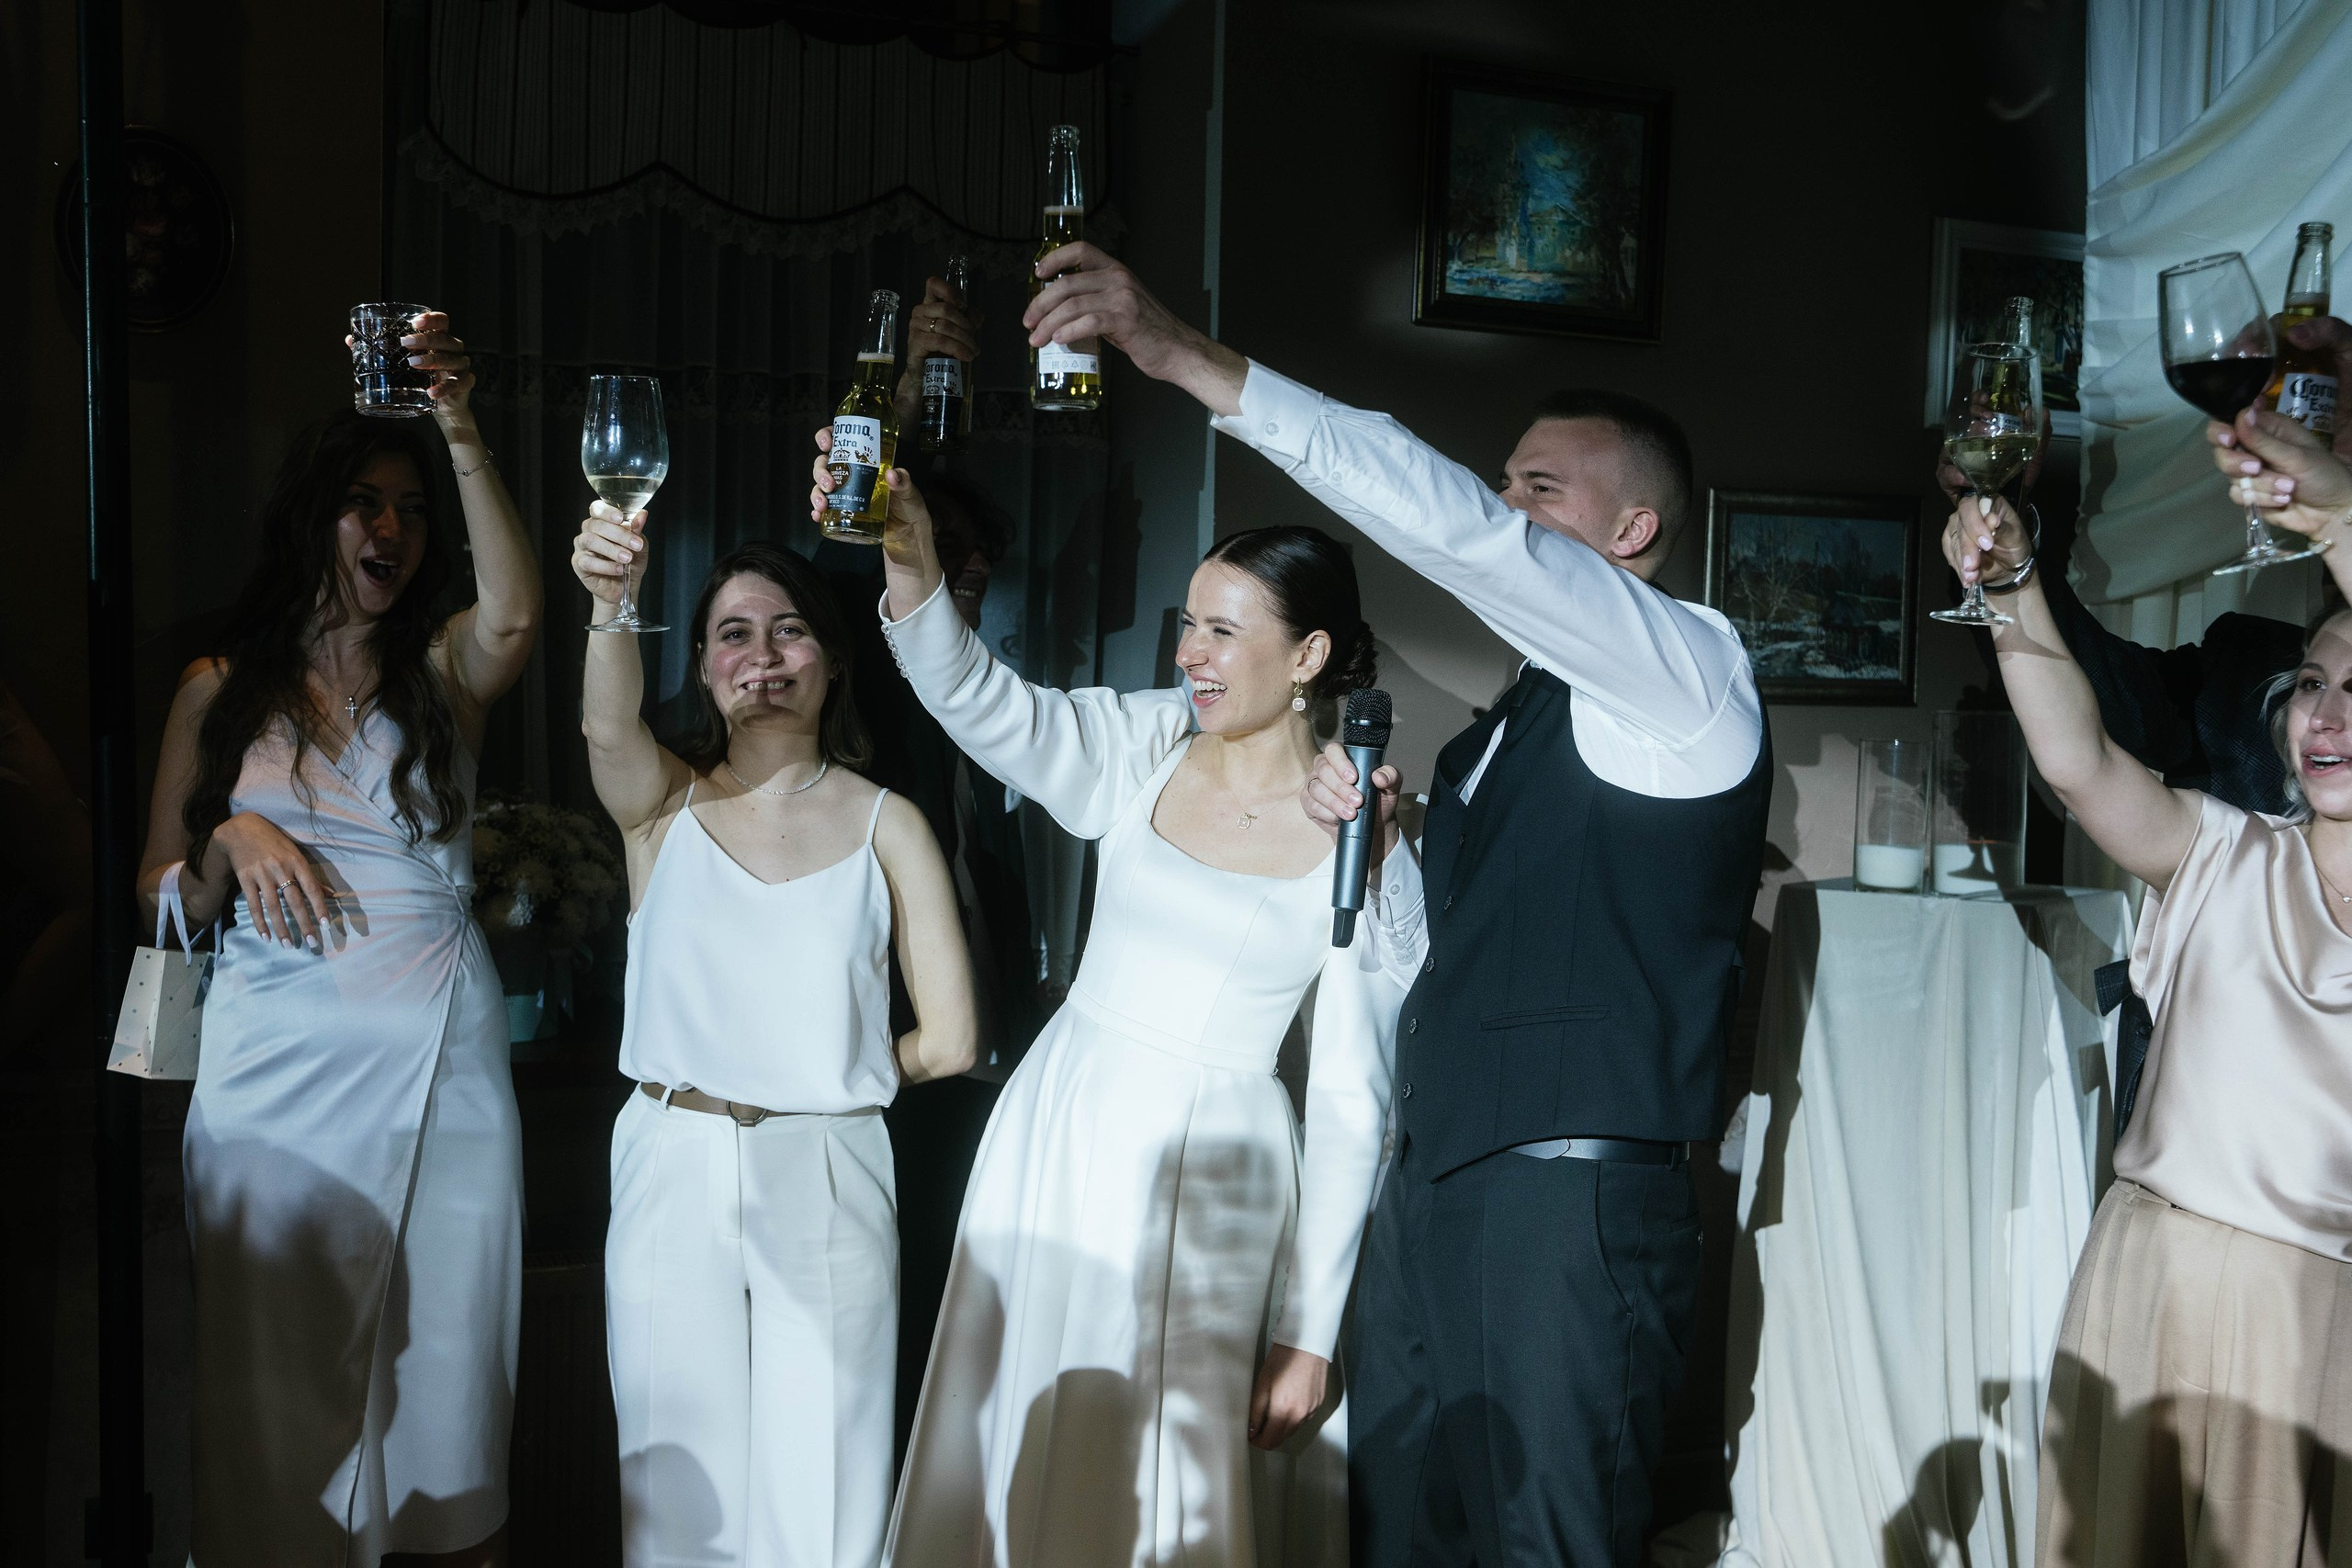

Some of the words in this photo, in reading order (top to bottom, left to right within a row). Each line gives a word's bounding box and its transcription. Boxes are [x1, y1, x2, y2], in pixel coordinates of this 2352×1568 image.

[925, 363, 956, 374] orona
[833, 421, 871, 437] orona
[832, 435, 857, 447] Extra
